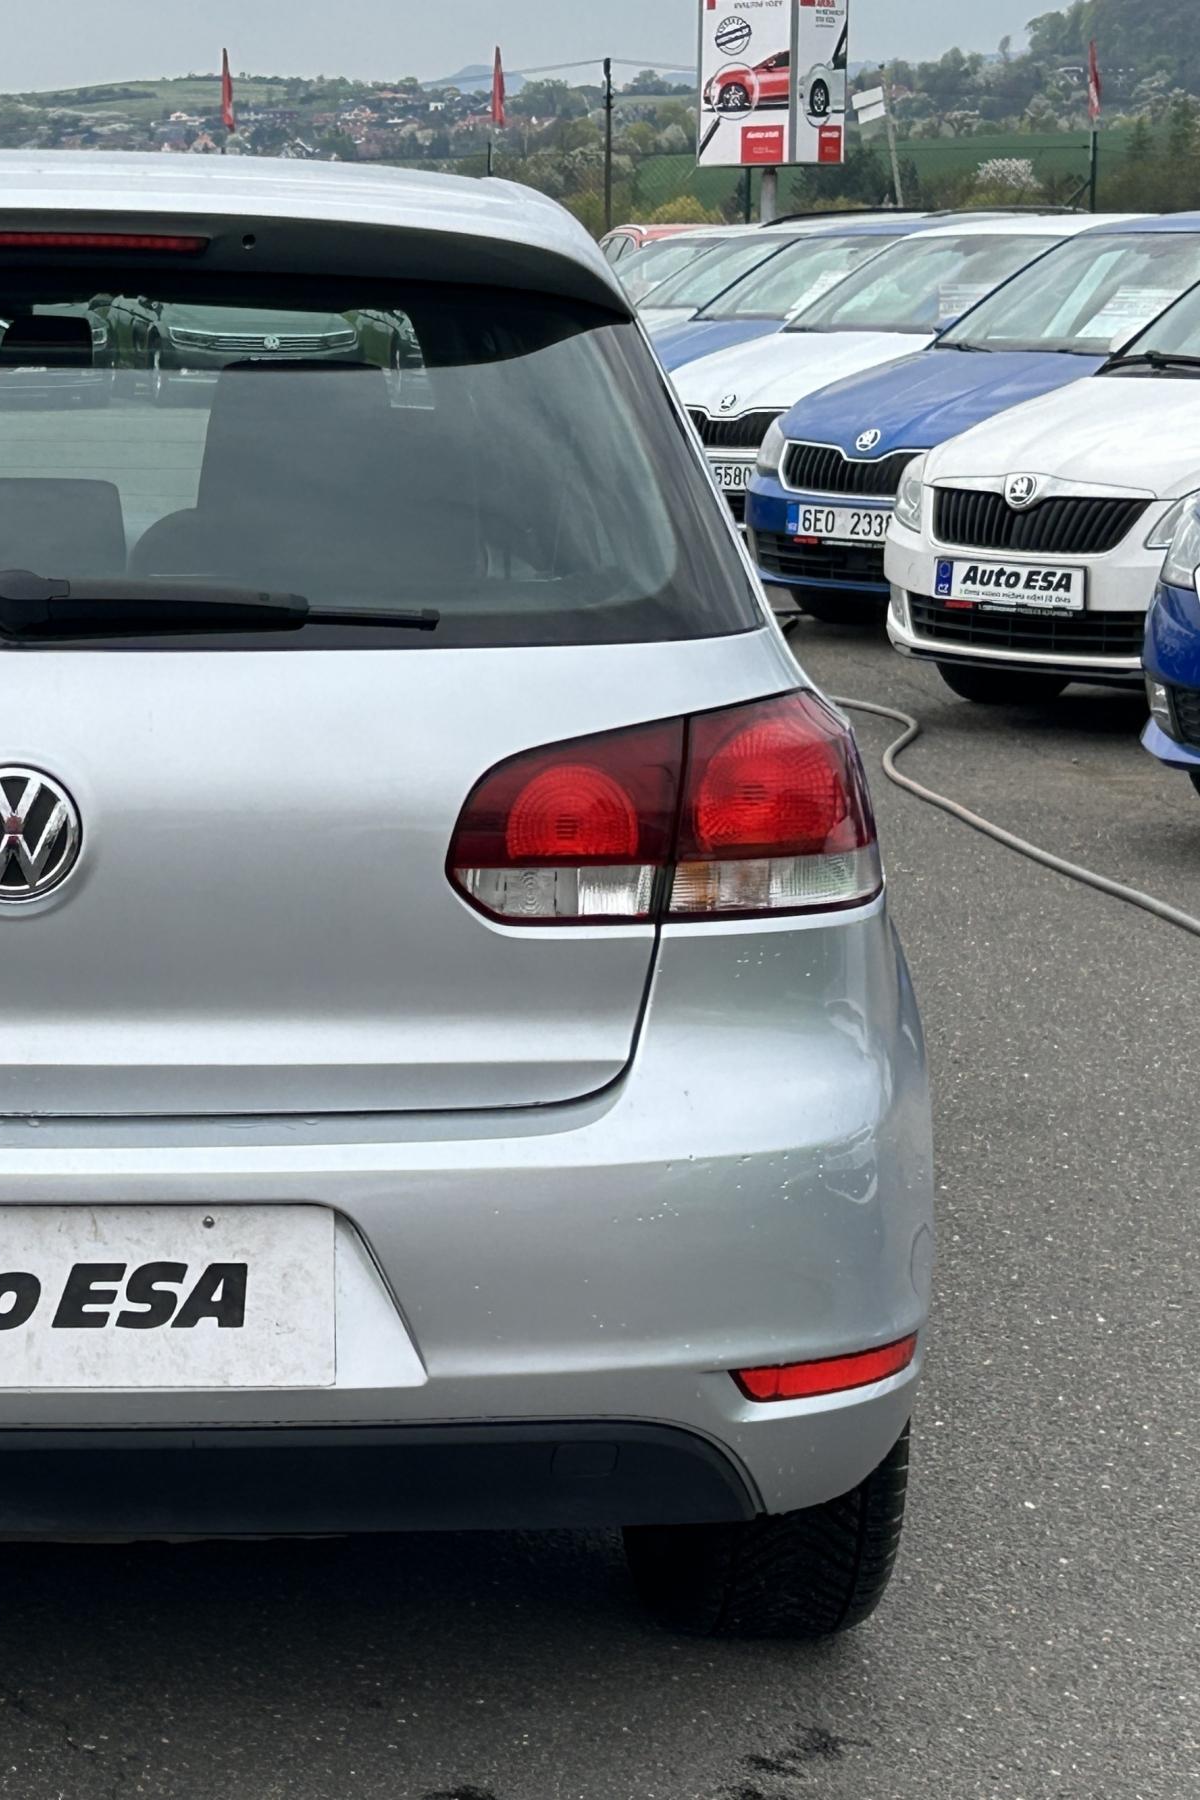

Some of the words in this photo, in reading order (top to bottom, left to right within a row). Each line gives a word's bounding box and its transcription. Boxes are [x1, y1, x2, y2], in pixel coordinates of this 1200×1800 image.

[960, 565, 1021, 589] Auto
[1023, 570, 1073, 593] ESA
[51, 1261, 249, 1329] ESA
